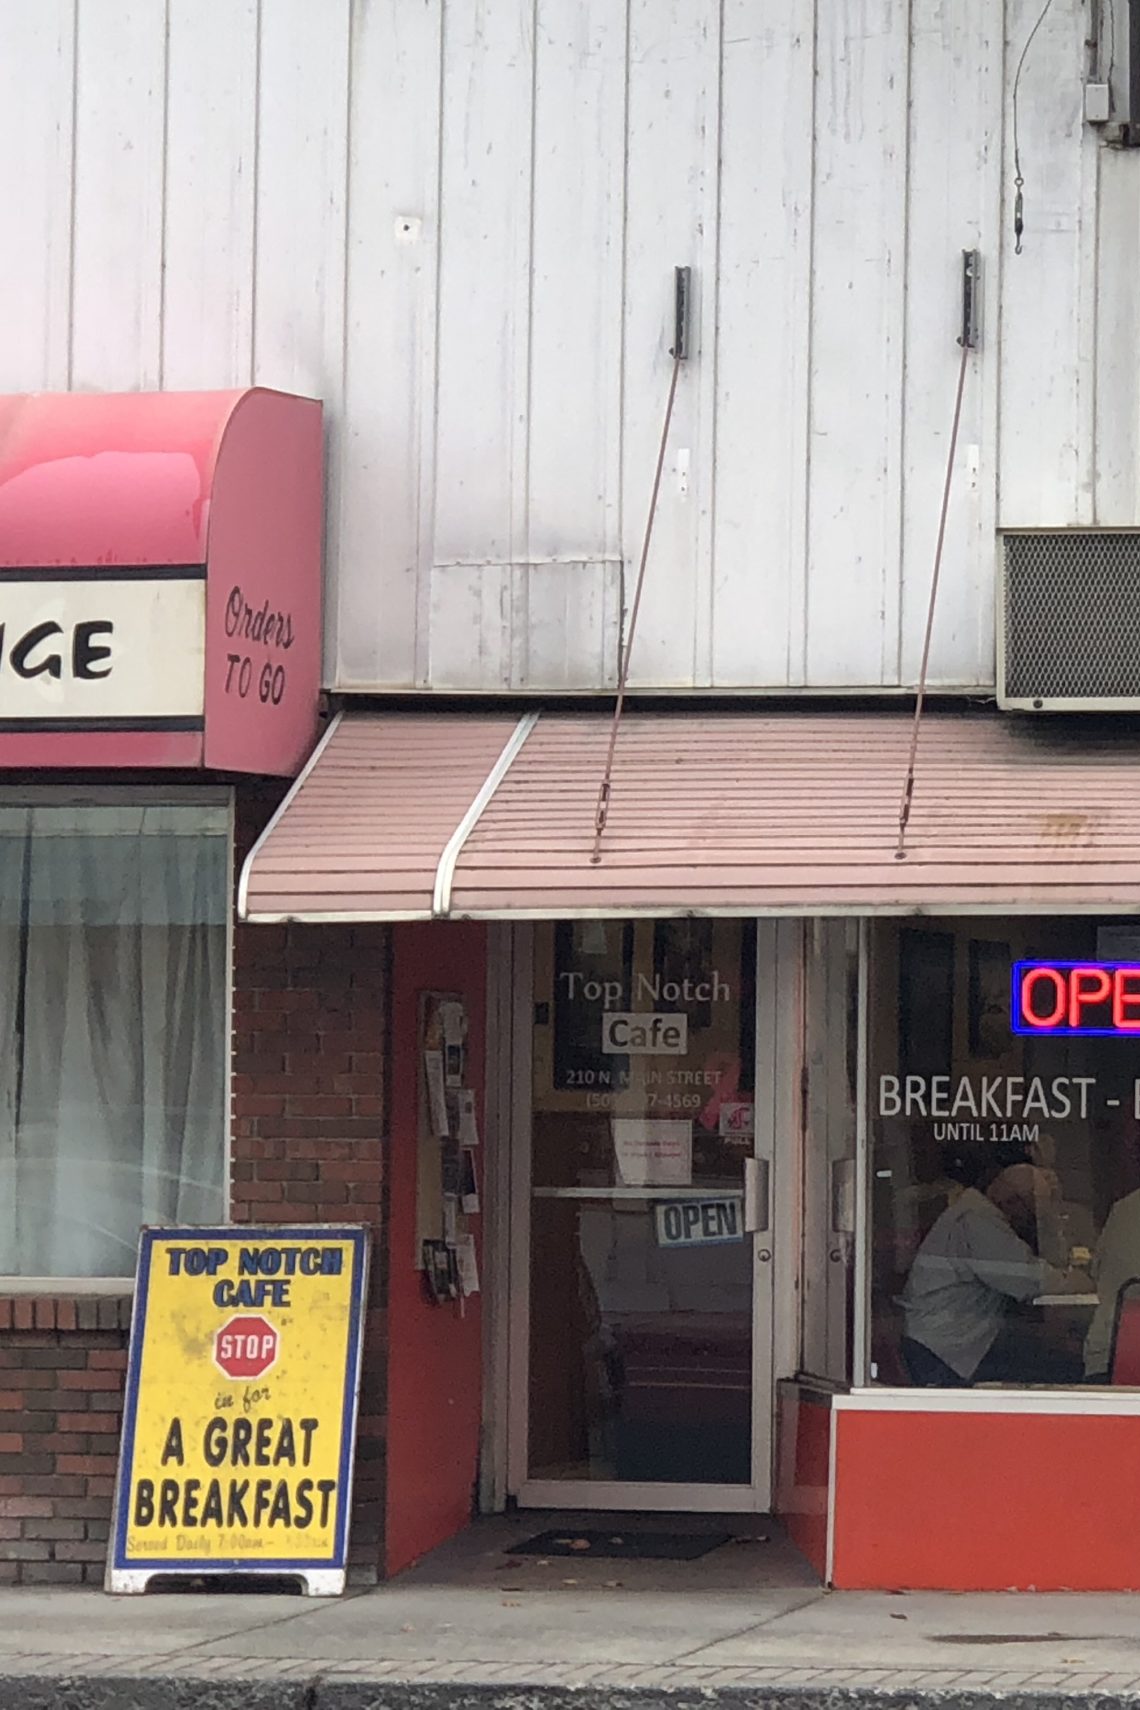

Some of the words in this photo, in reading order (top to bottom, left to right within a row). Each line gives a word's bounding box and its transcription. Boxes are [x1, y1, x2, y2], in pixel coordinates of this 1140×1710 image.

[225, 586, 295, 650] Orders
[225, 653, 252, 699] TO
[258, 664, 286, 706] GO
[560, 971, 623, 1009] Top
[637, 970, 731, 1002] Notch
[608, 1018, 682, 1048] Cafe
[566, 1070, 595, 1085] 210
[667, 1070, 723, 1086] STREET
[878, 1074, 1096, 1119] BREAKFAST
[934, 1122, 985, 1141] UNTIL
[988, 1123, 1040, 1142] 11AM
[663, 1203, 738, 1241] OPEN
[166, 1247, 229, 1277] TOP
[238, 1246, 344, 1277] NOTCH
[212, 1278, 291, 1308] CAFE
[220, 1335, 275, 1359] STOP
[214, 1391, 235, 1411] in
[242, 1385, 272, 1413] for
[160, 1417, 185, 1468] A
[203, 1416, 319, 1468] GREAT
[133, 1477, 337, 1529] BREAKFAST
[175, 1532, 212, 1555] Daily
